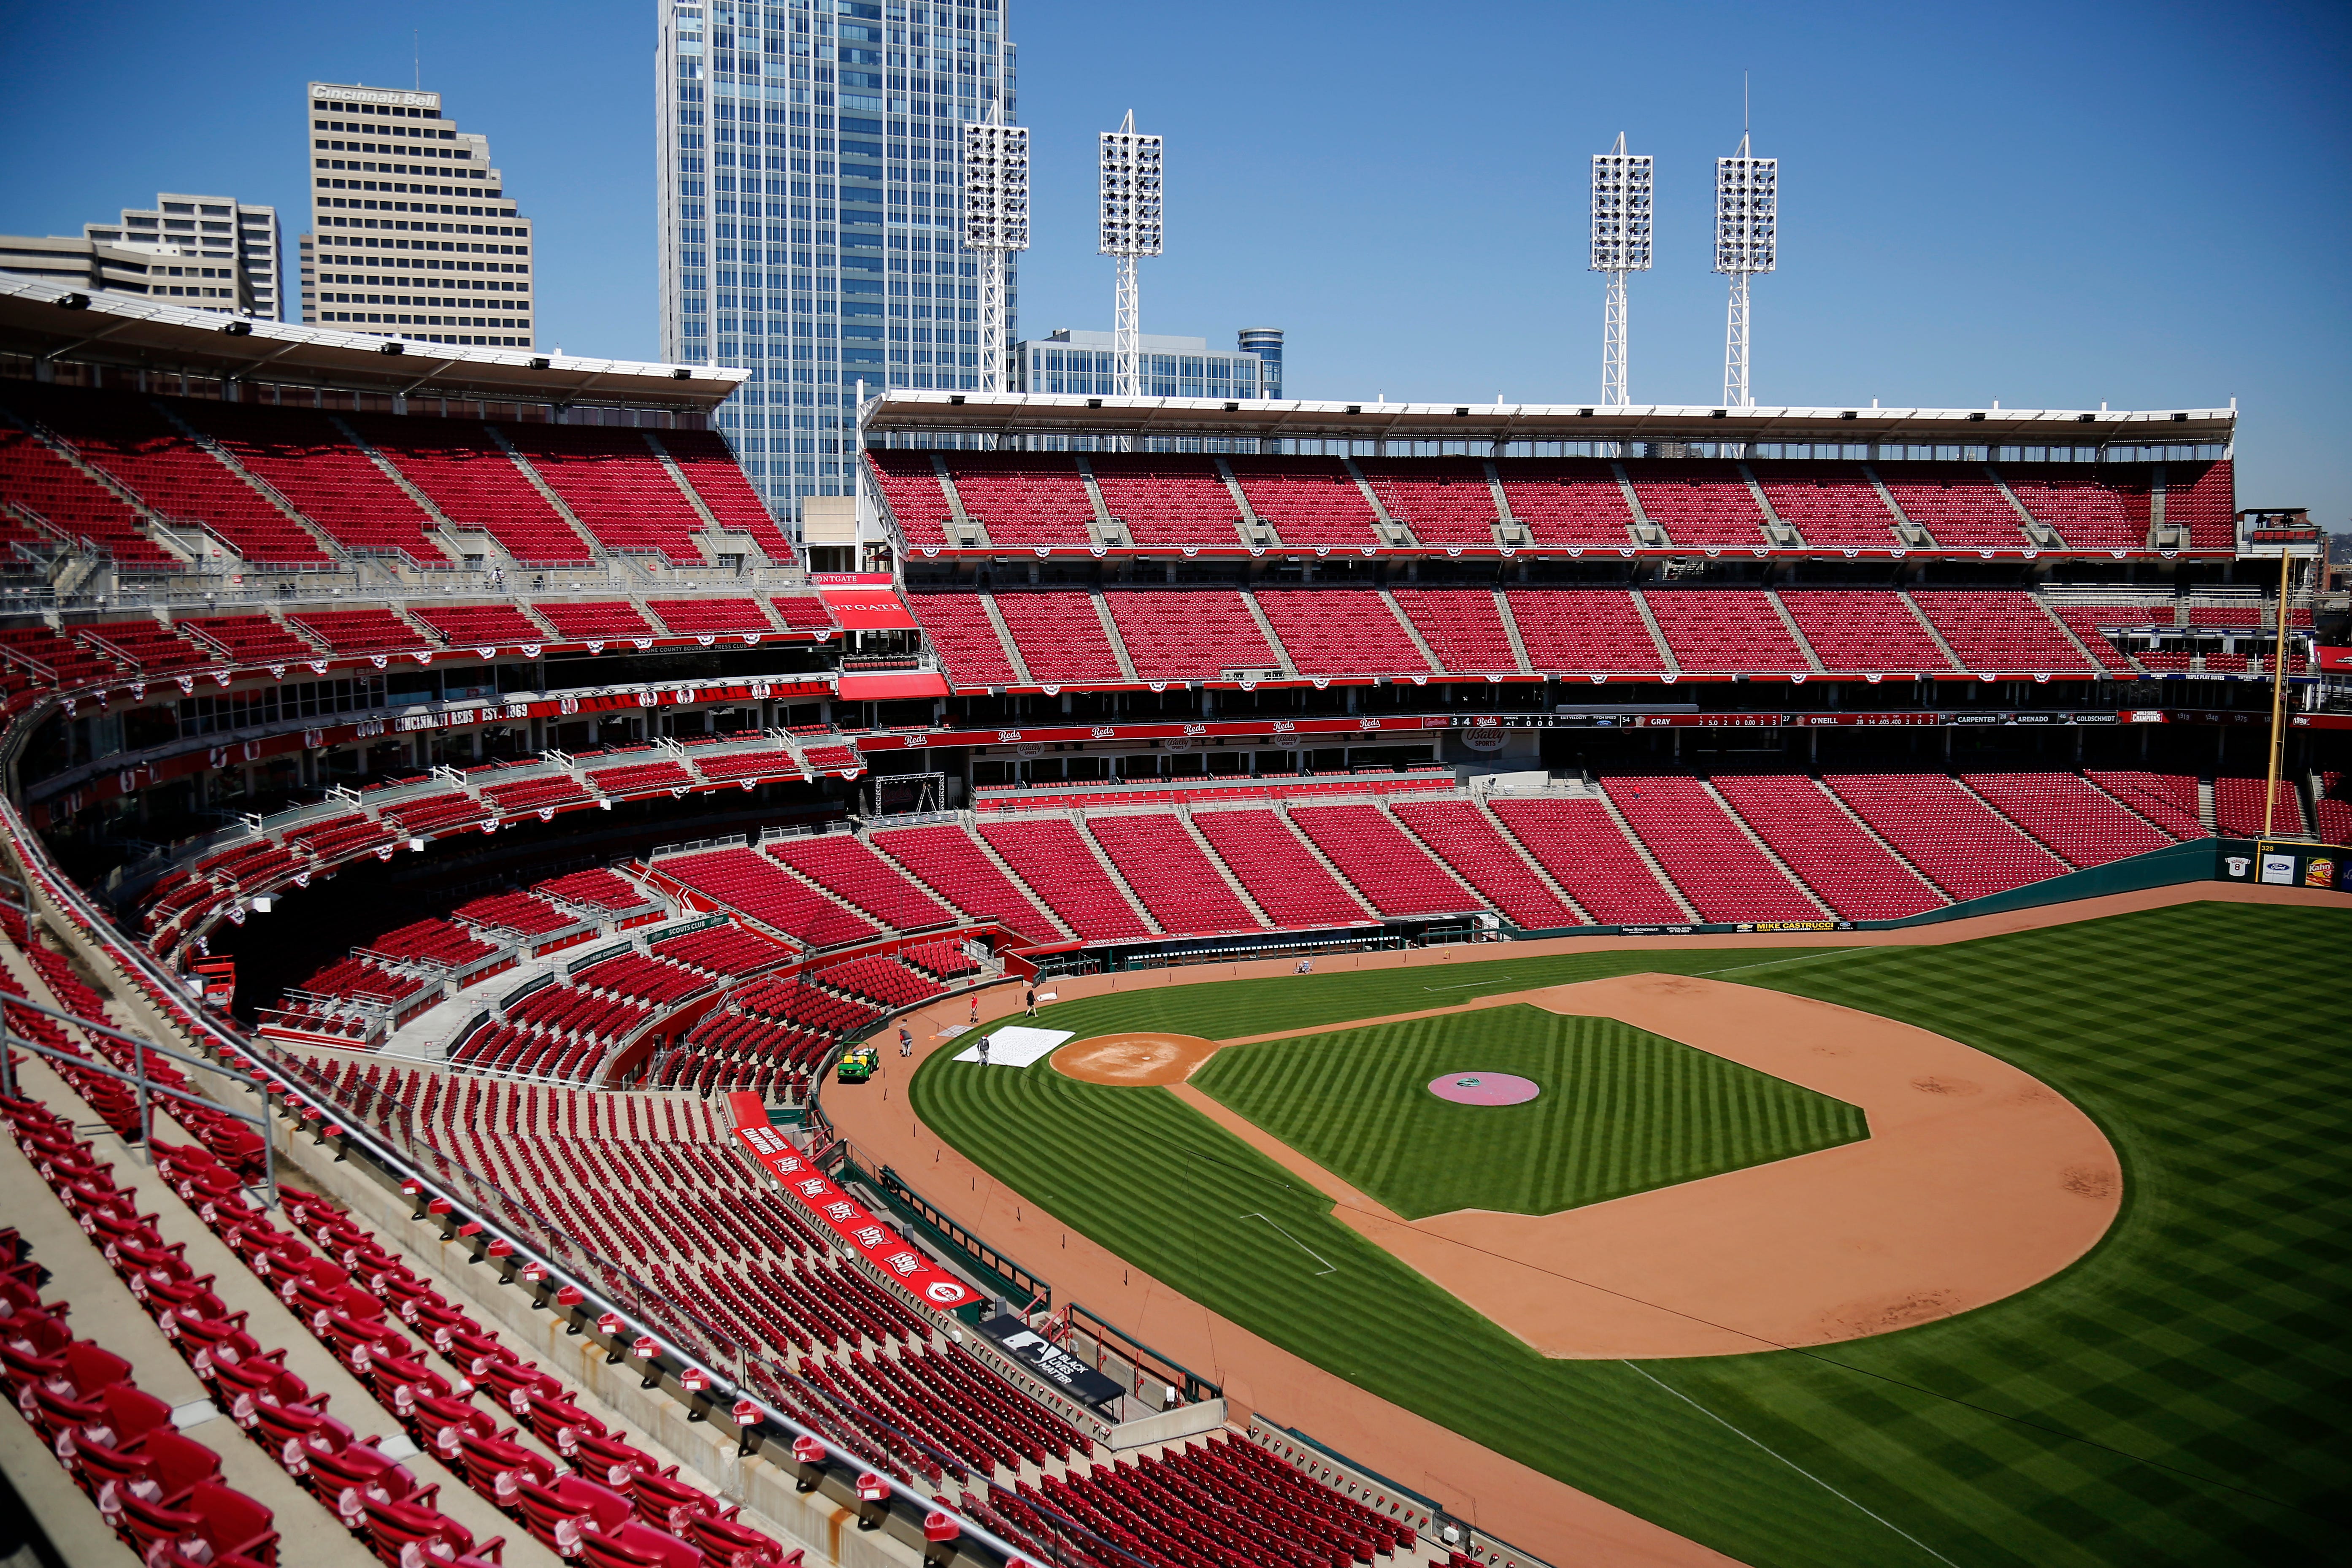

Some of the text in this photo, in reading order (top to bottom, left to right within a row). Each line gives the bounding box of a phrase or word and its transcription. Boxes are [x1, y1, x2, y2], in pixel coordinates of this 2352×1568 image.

[313, 85, 437, 107] Cincinnati Bell
[395, 704, 527, 732] CINCINNATI REDS EST. 1869
[1360, 718, 1381, 730] Reds
[1452, 717, 1457, 725] 3
[1463, 717, 1470, 725] 4
[1477, 716, 1497, 727] Reds
[2133, 714, 2160, 722] CHAMPIONS
[1091, 726, 1114, 739] Reds
[1184, 723, 1206, 735] Reds
[1273, 721, 1295, 733] Reds
[904, 734, 927, 747] Reds
[998, 730, 1021, 743] Reds
[1167, 738, 1188, 747] Bally
[1277, 735, 1298, 743] Bally
[1467, 729, 1506, 743] Bally
[1019, 743, 1042, 752] Bally
[2309, 862, 2335, 872] Kahn's
[669, 921, 705, 935] SCOUTS CLUB
[570, 944, 630, 971] BELTERRA PARK CINCINNATI
[528, 975, 553, 990] CINCINNATI
[741, 1127, 776, 1155] CHAMPIONS
[758, 1126, 788, 1150] WORLD SERIES
[778, 1157, 798, 1172] 1919
[800, 1179, 823, 1195] 1940
[828, 1202, 852, 1219] 1975
[858, 1227, 882, 1245] 1976
[890, 1253, 918, 1273] 1990
[937, 1287, 958, 1301] REDS
[1049, 1358, 1074, 1375] LIVES
[1058, 1354, 1089, 1374] BLACK
[1038, 1362, 1072, 1384] MATTER
